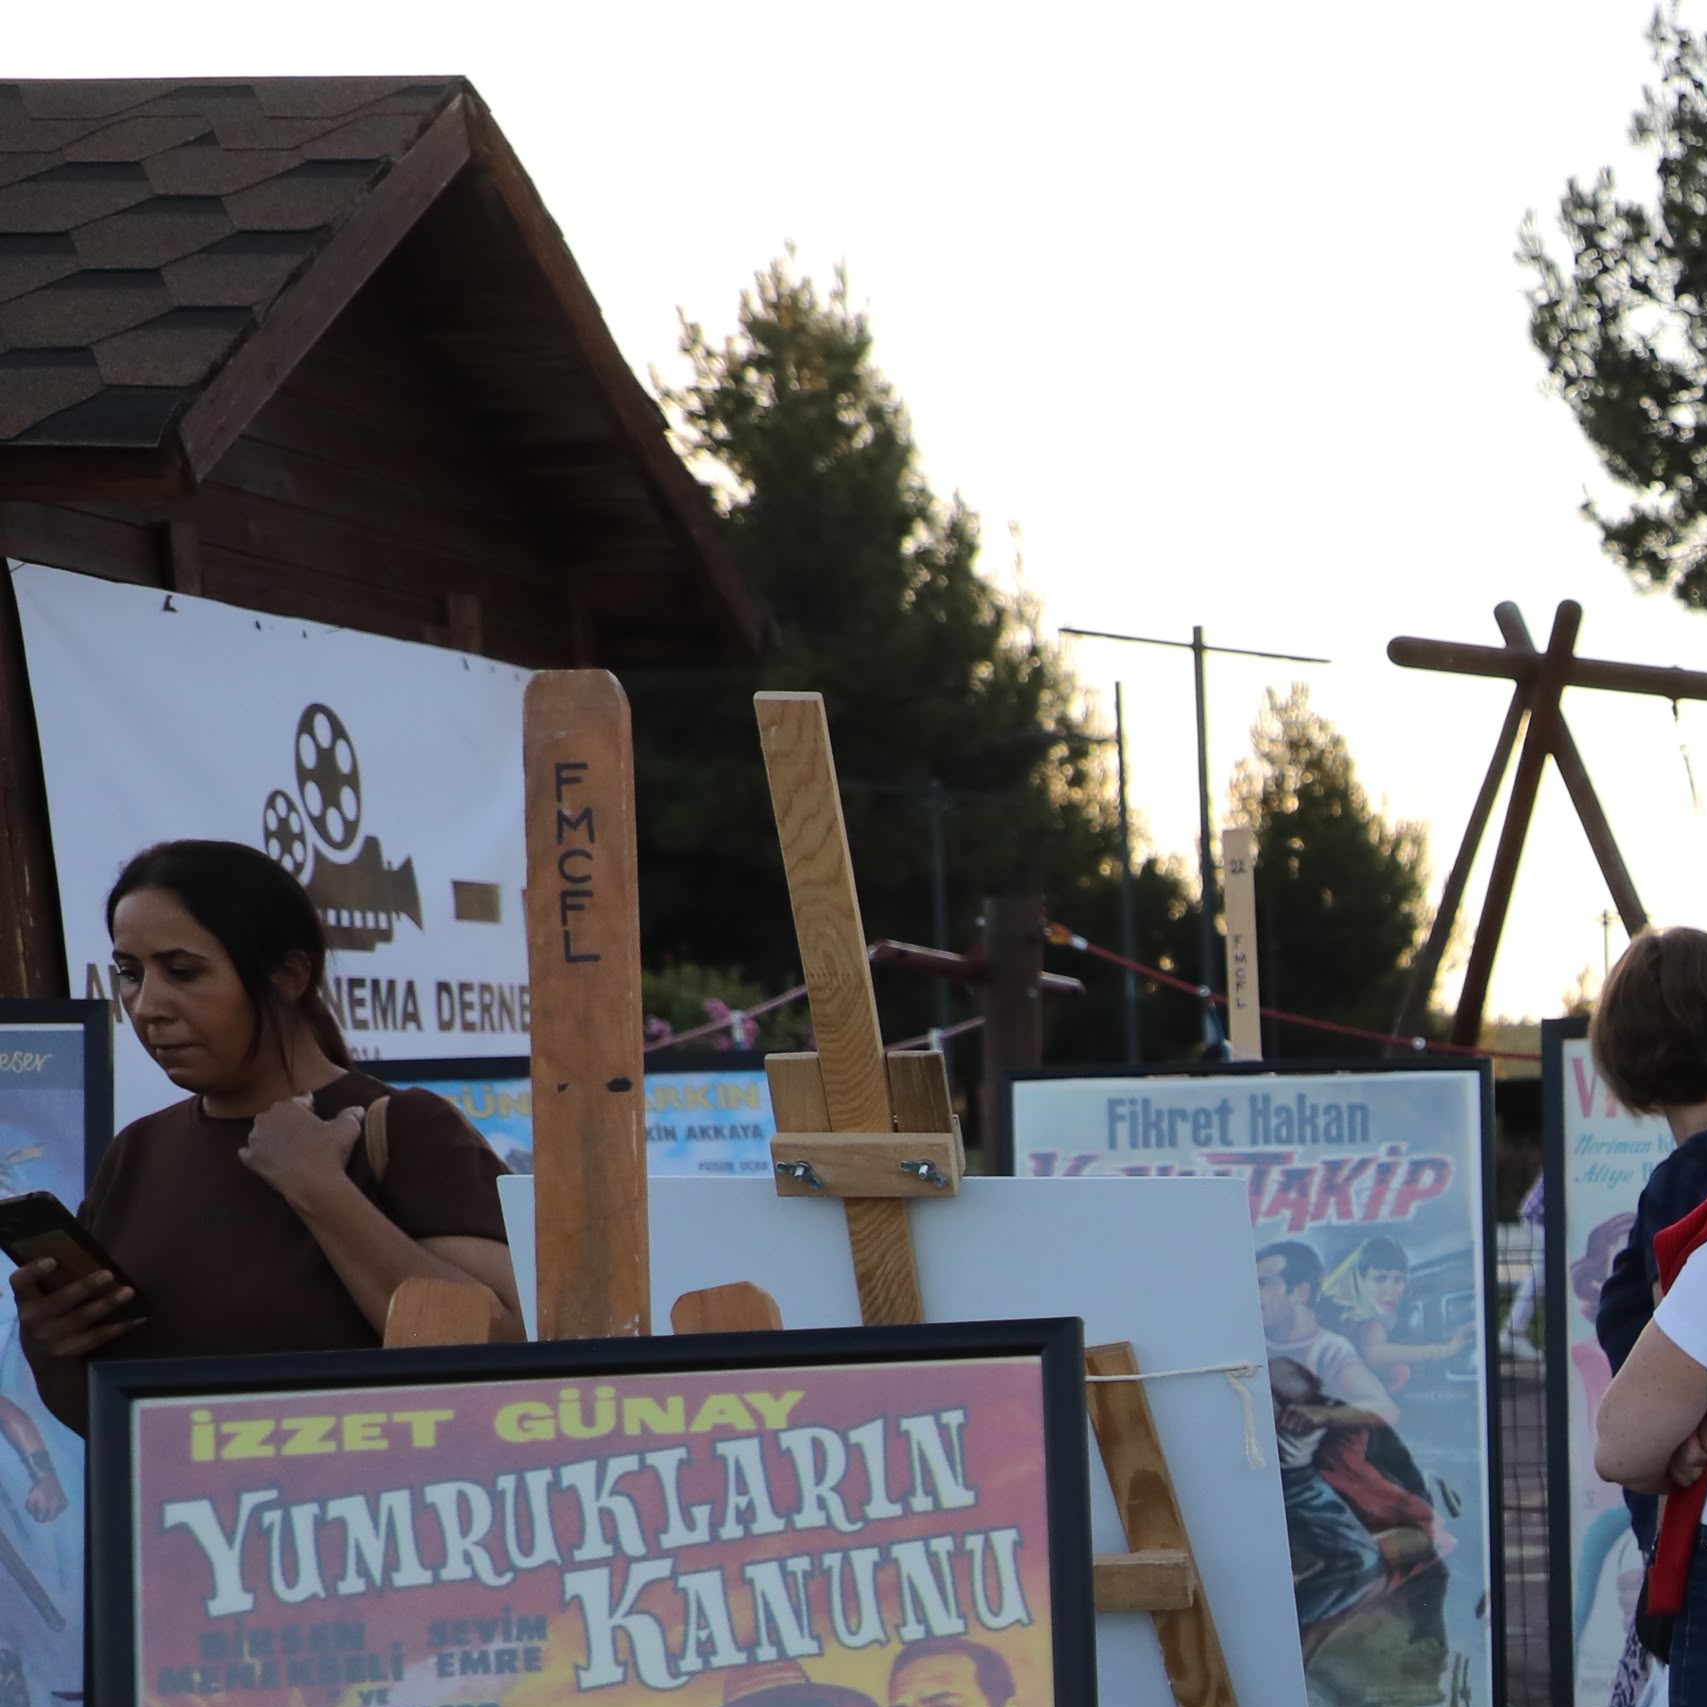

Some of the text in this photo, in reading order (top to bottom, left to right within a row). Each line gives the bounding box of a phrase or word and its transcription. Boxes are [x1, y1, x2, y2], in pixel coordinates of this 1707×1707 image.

[322, 976, 531, 1034] NEMA DERNE
[1107, 1092, 1370, 1151] Fikret Hakan
[189, 1386, 808, 1463] İZZET GÜNAY
[162, 1407, 979, 1617] YUMRUKLARIN
[563, 1526, 1034, 1691] KANUNU
[436, 1646, 543, 1679] EMRE
[358, 1687, 391, 1707] VE
